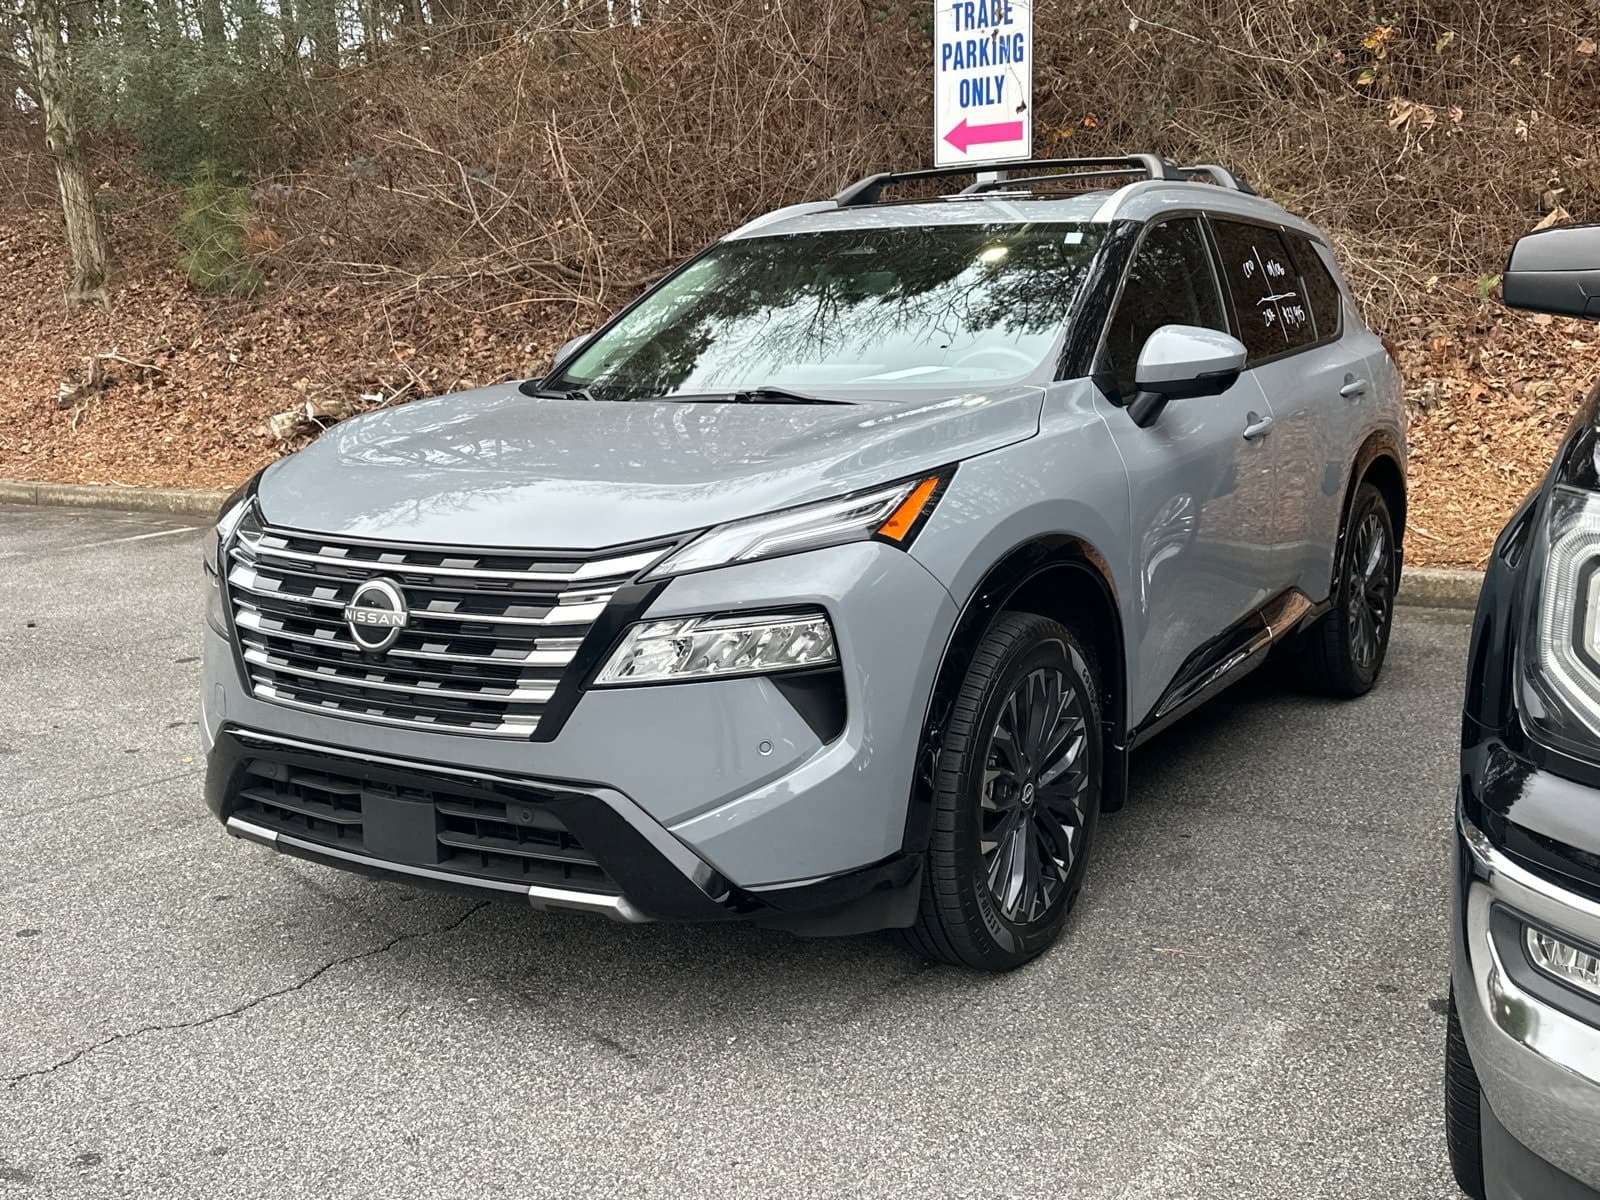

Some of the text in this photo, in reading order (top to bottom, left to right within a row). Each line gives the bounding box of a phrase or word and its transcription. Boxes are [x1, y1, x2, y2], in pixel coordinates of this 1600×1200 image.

[952, 0, 1013, 32] TRADE
[942, 32, 1024, 72] PARKING
[959, 75, 1005, 109] ONLY
[344, 608, 405, 626] NISSAN
